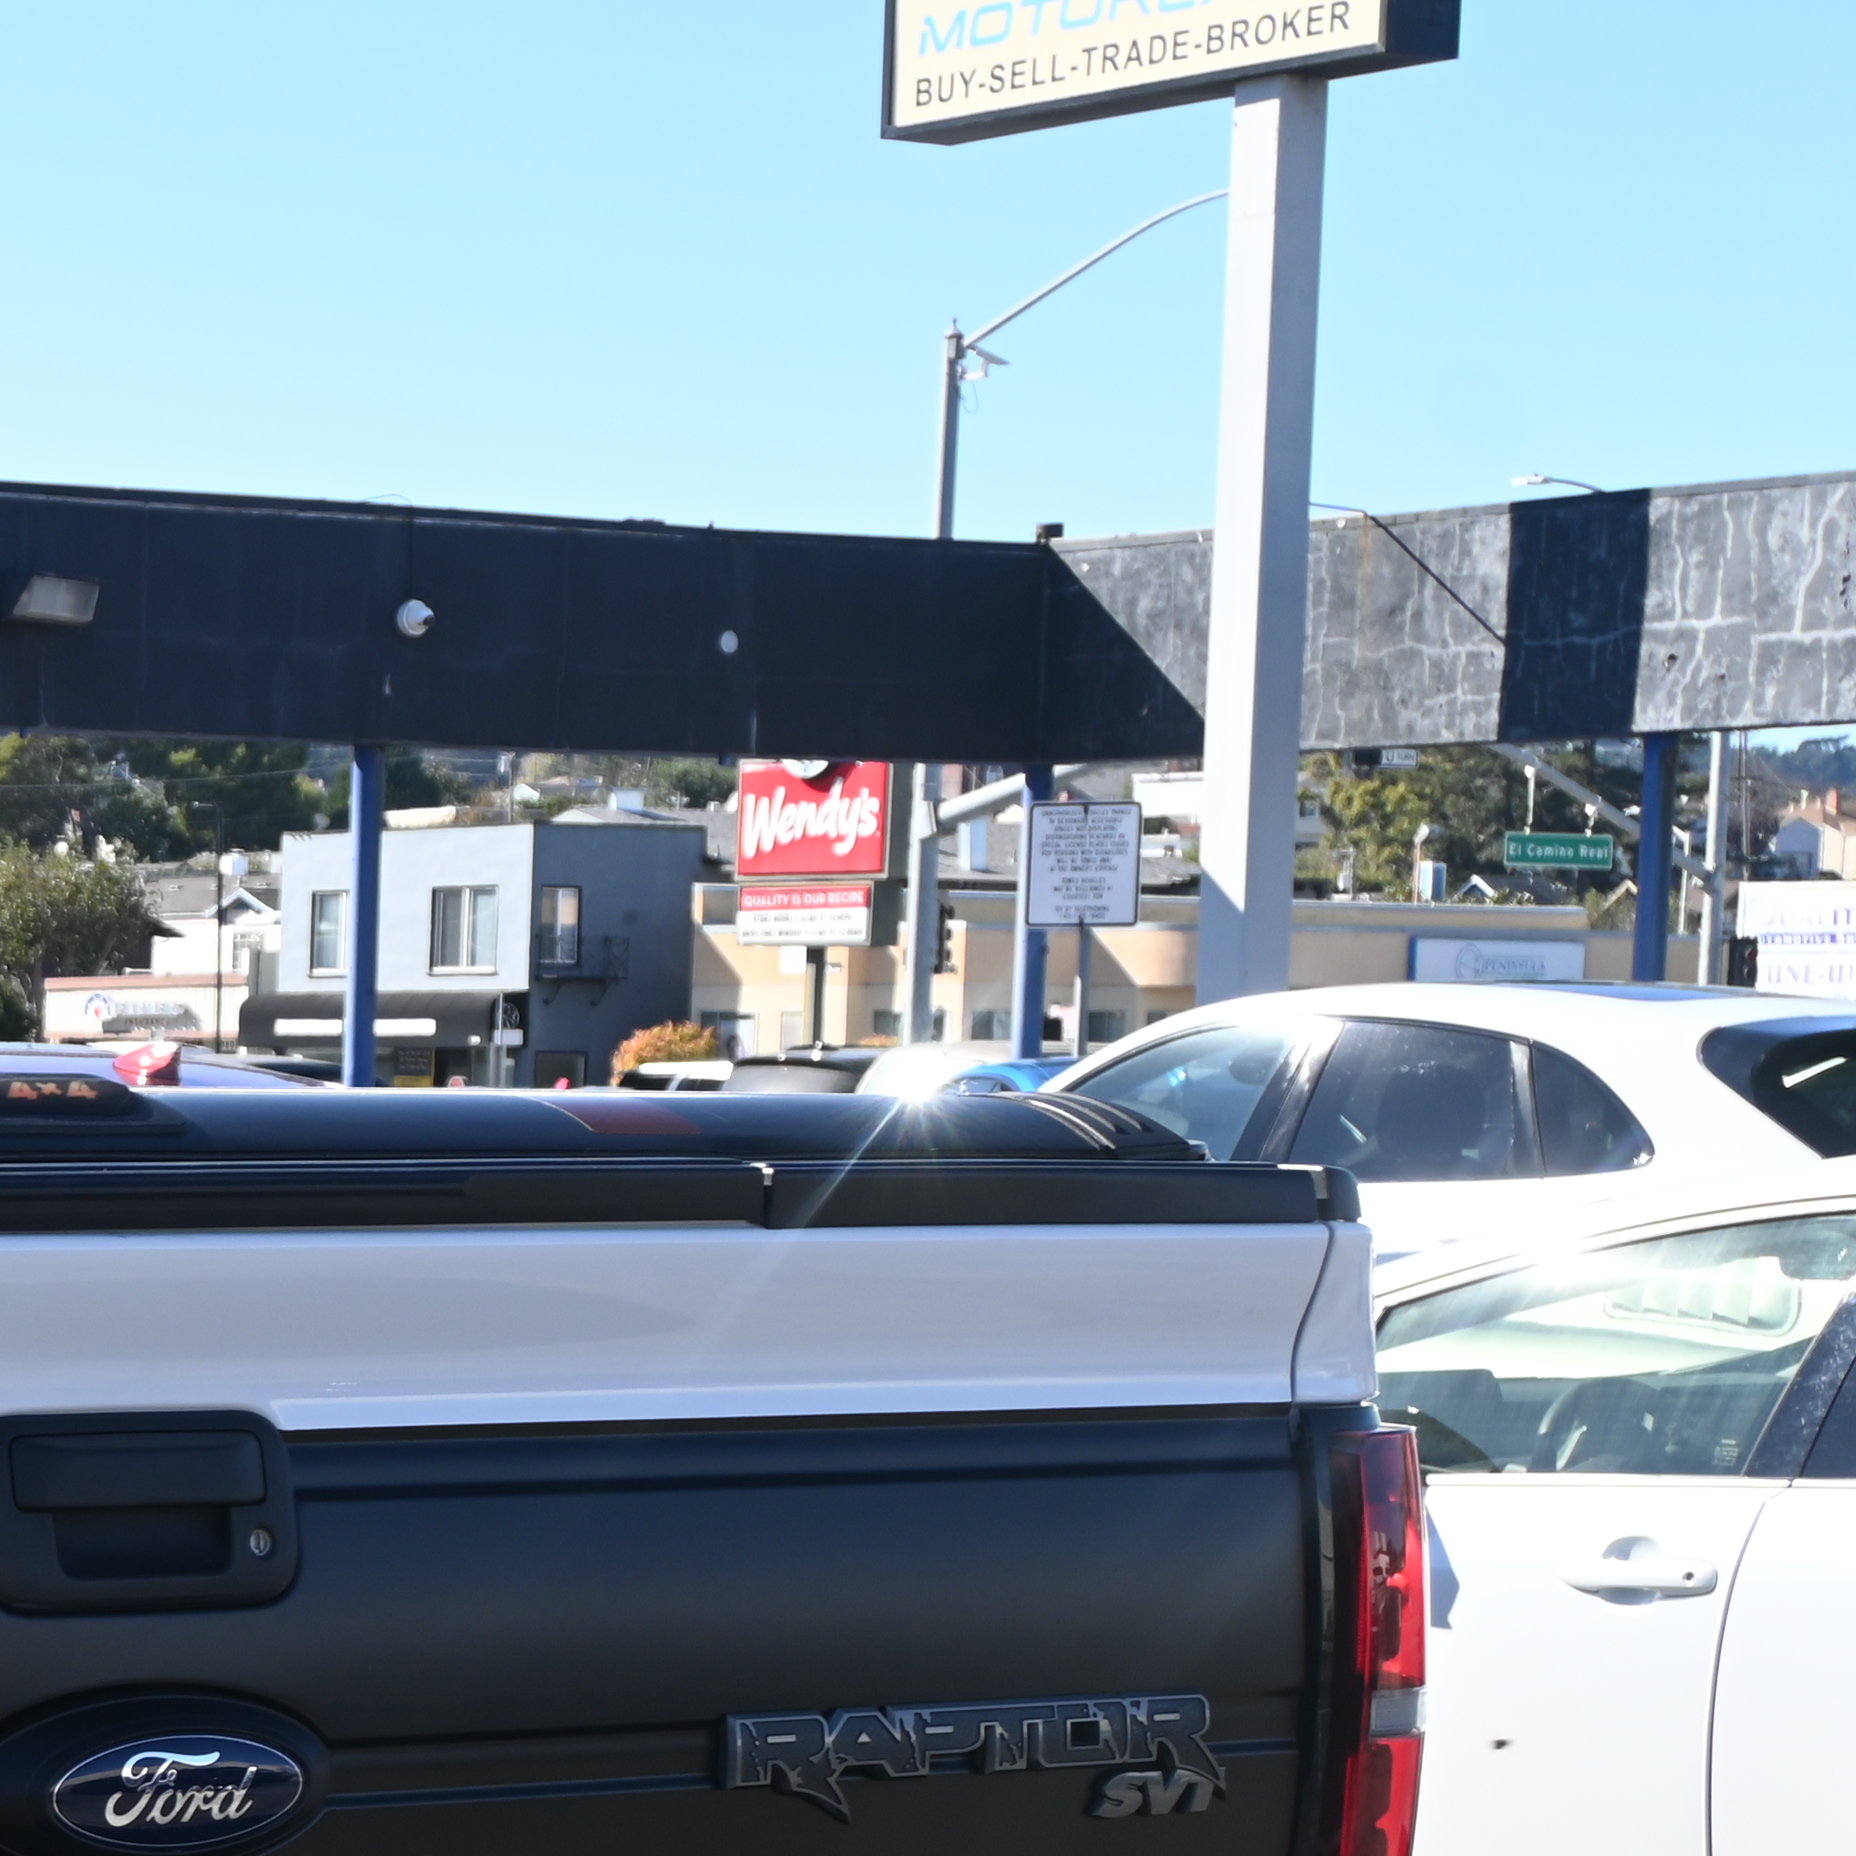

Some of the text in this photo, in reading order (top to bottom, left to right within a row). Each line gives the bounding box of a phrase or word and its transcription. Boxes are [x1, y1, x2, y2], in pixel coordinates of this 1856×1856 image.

[915, 0, 1351, 107] BUY-SELL-TRADE-BROKER
[743, 777, 880, 859] Wendy's
[1508, 841, 1609, 859] El Camino Real
[743, 890, 864, 907] QUALITY IS OUR RECIPE
[104, 1750, 258, 1827] Ford
[722, 1690, 1226, 1824] RAPTOR
[1089, 1768, 1219, 1820] SVT
